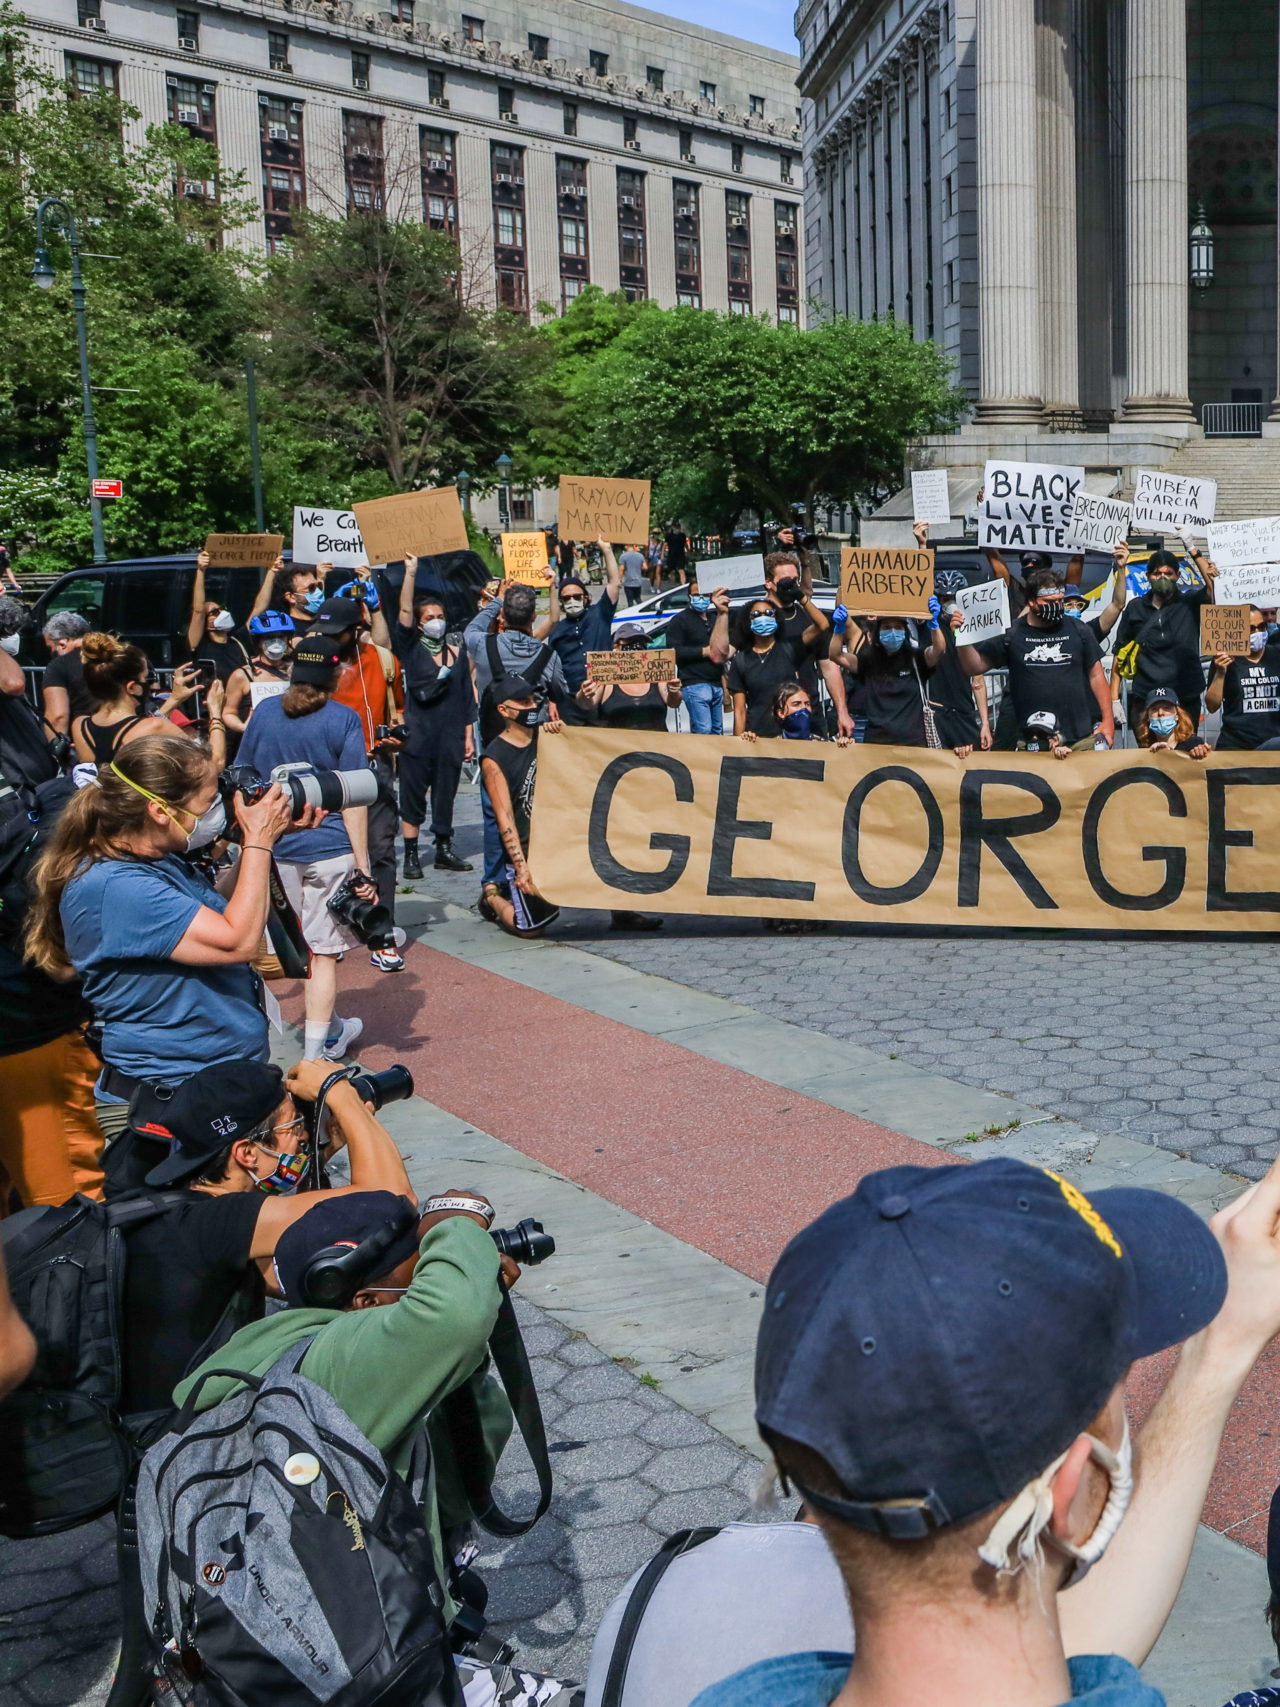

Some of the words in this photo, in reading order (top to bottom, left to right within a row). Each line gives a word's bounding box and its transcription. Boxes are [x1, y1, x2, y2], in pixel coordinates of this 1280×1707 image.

[991, 470, 1080, 502] BLACK
[1141, 474, 1201, 497] RUBÉN
[567, 483, 645, 511] TRAYVON
[1137, 492, 1198, 510] GARCIA
[986, 501, 1073, 527] LIVES
[1074, 496, 1131, 523] BREONNA
[300, 511, 324, 528] We
[336, 513, 360, 530] Ca
[566, 509, 635, 533] MARTIN
[987, 524, 1080, 550] MATTE
[1073, 518, 1122, 544] TAYLOR
[219, 537, 264, 546] JUSTICE
[508, 538, 538, 547] GEORGE
[1213, 539, 1249, 550] ABOLISH
[509, 550, 541, 558] FLOYD'S
[1230, 546, 1270, 558] POLICE
[847, 552, 930, 571] AHMAUD
[508, 570, 545, 578] MATTERS
[1238, 567, 1271, 578] GARNER
[847, 571, 927, 597] ARBERY
[1232, 578, 1259, 586] GEORGE
[961, 587, 998, 610] ERIC
[1206, 609, 1219, 618] MY
[1222, 608, 1242, 618] SKIN
[959, 609, 1003, 633] GARNER
[1205, 619, 1245, 630] COLOUR
[1211, 630, 1220, 639] IS
[1225, 631, 1243, 640] NOT
[1205, 640, 1212, 651] A
[1216, 640, 1248, 652] CRIME!
[653, 650, 667, 660] I
[647, 661, 672, 670] CAN'T
[1248, 667, 1265, 677] MY
[1257, 676, 1280, 684] COLOR
[257, 686, 280, 695] END
[1243, 686, 1255, 698] IS
[1256, 684, 1278, 698] NOT
[1247, 701, 1252, 710] A
[1254, 699, 1277, 710] CRIME
[248, 1564, 284, 1616] UNDER
[281, 1617, 330, 1676] ARMOUR
